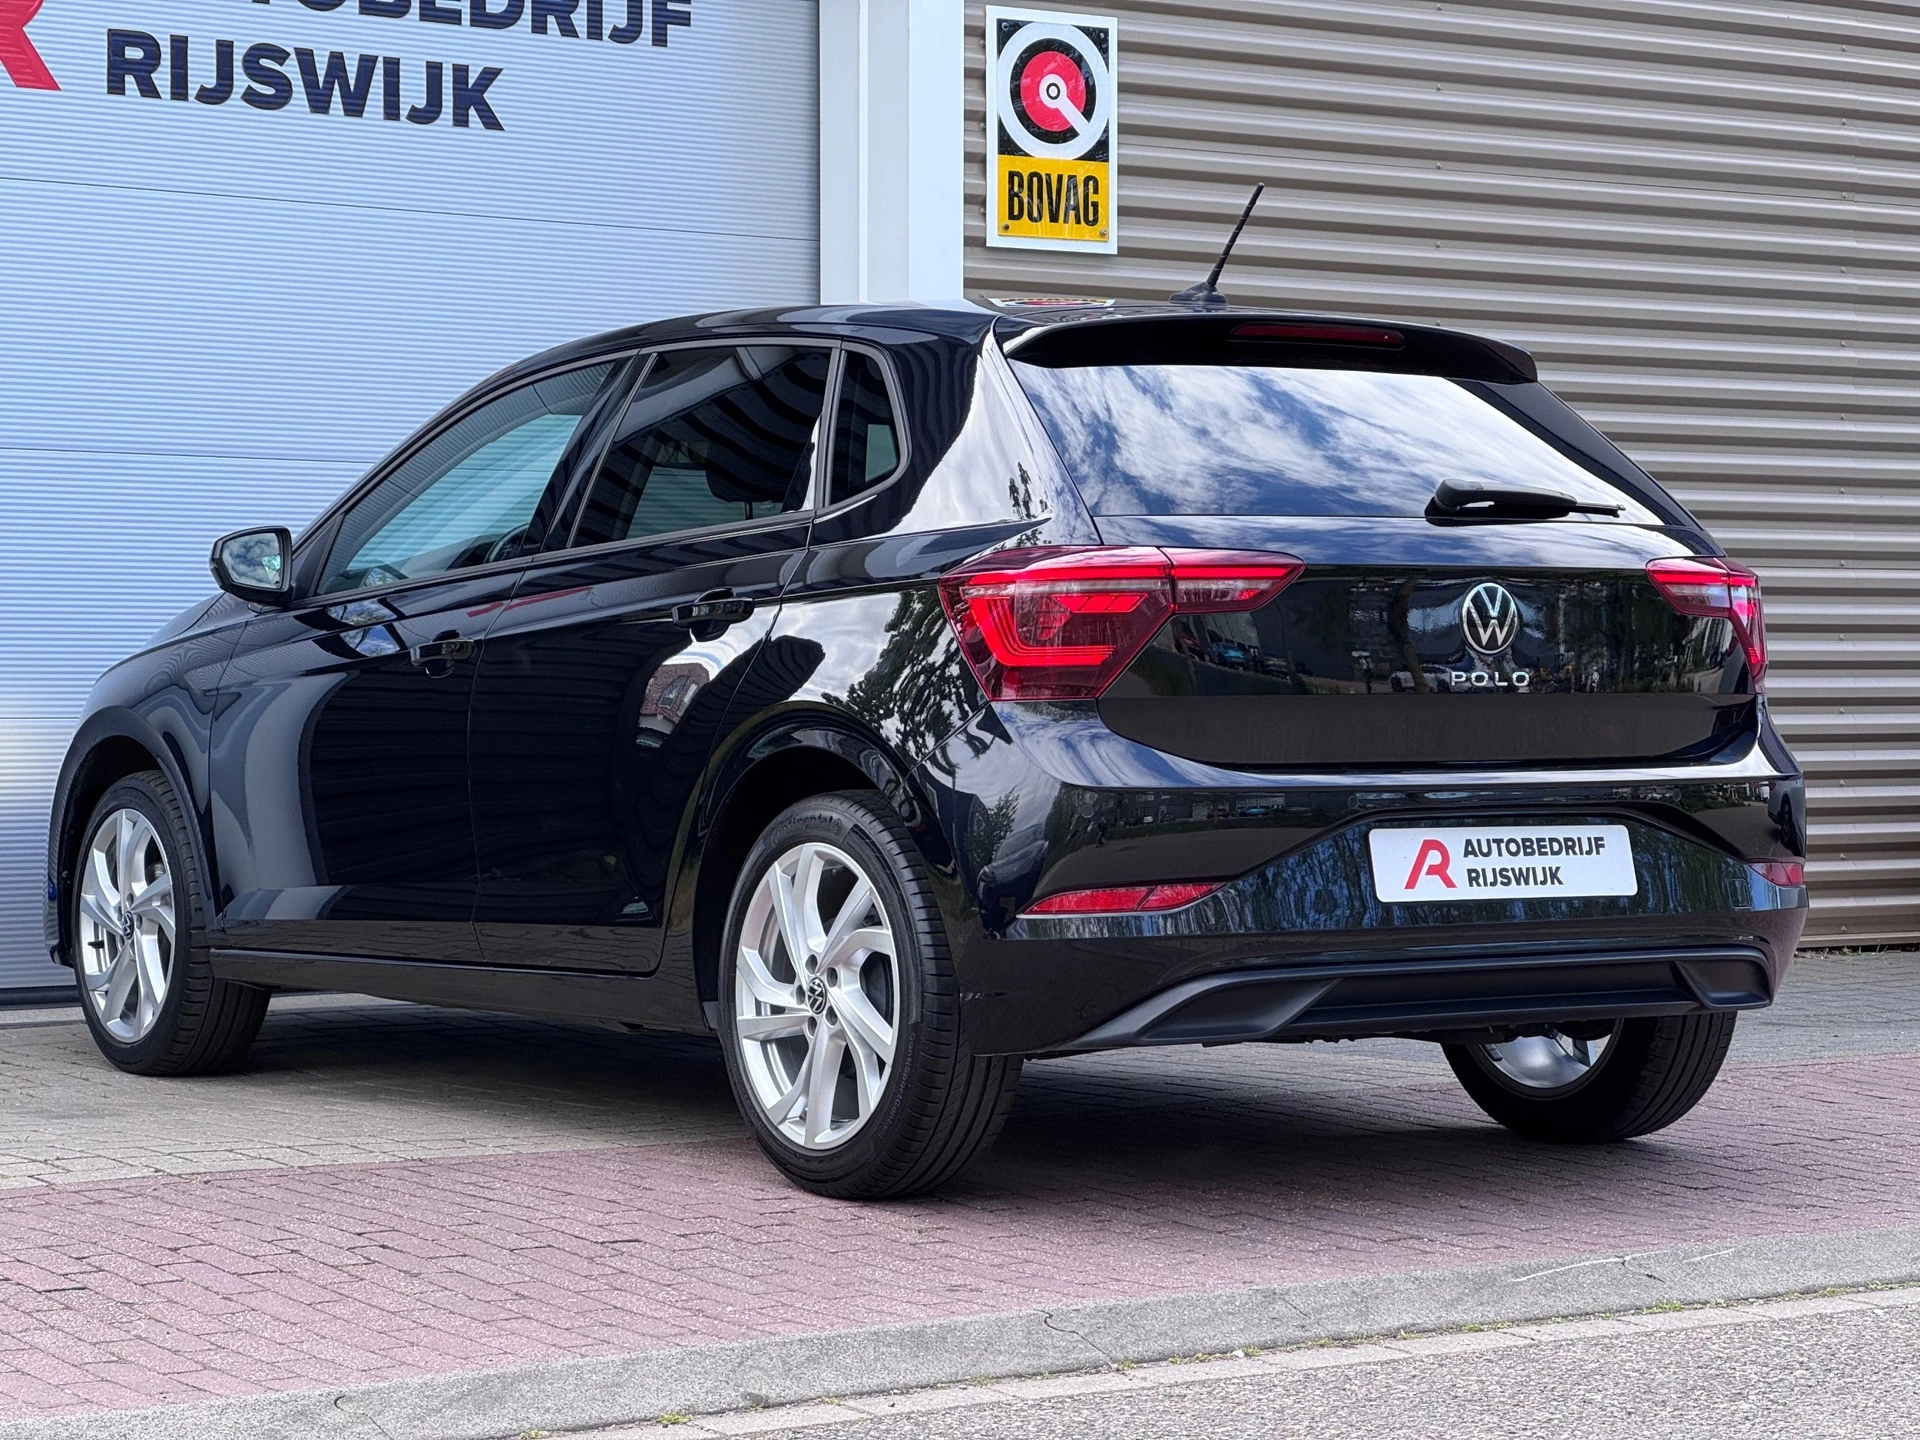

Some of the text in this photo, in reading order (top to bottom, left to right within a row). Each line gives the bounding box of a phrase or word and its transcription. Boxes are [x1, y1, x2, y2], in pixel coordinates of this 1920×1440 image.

[106, 28, 505, 131] RIJSWIJK
[1007, 171, 1099, 226] BOVAG
[1450, 671, 1531, 687] POLO
[1463, 836, 1606, 859] AUTOBEDRIJF
[1466, 866, 1565, 888] RIJSWIJK
